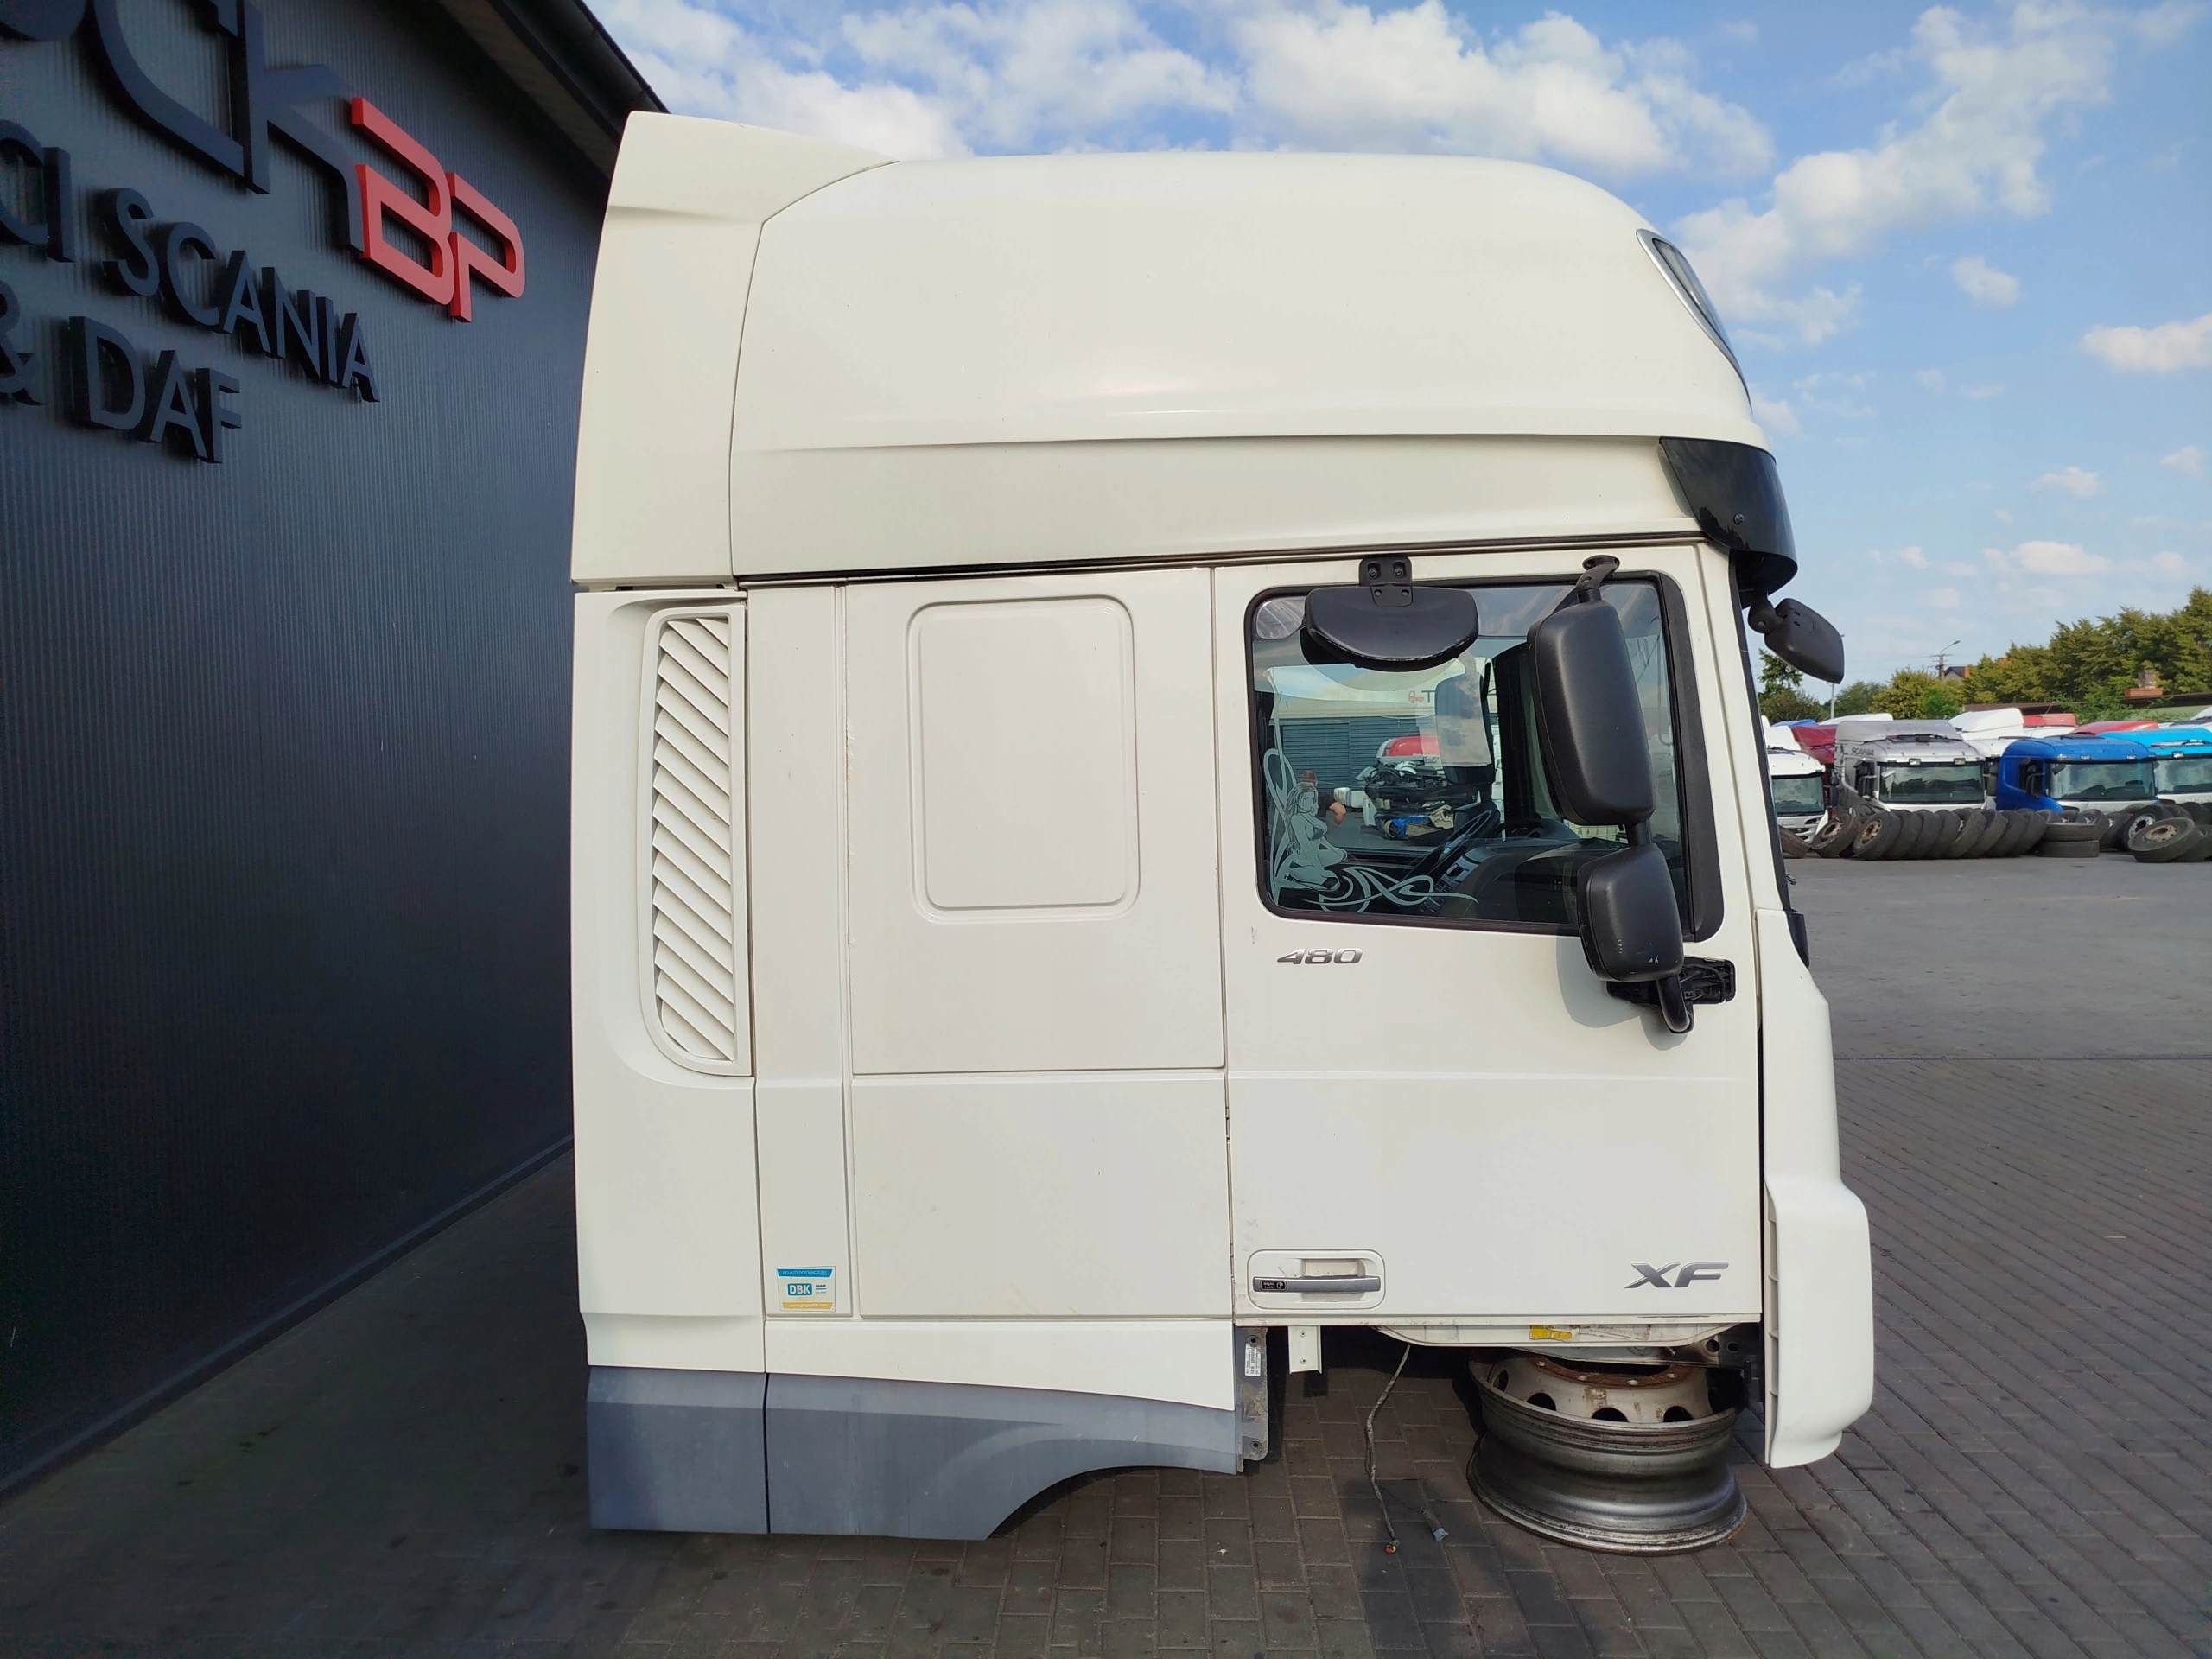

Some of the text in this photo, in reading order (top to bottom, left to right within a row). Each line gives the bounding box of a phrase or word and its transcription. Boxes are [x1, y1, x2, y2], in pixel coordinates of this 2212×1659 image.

[111, 188, 380, 403] SCANIA
[73, 315, 242, 463] DAF
[1852, 747, 1874, 757] SCANIA
[1276, 948, 1363, 965] 480
[1624, 1262, 1729, 1288] XF
[789, 1284, 811, 1294] DBK
